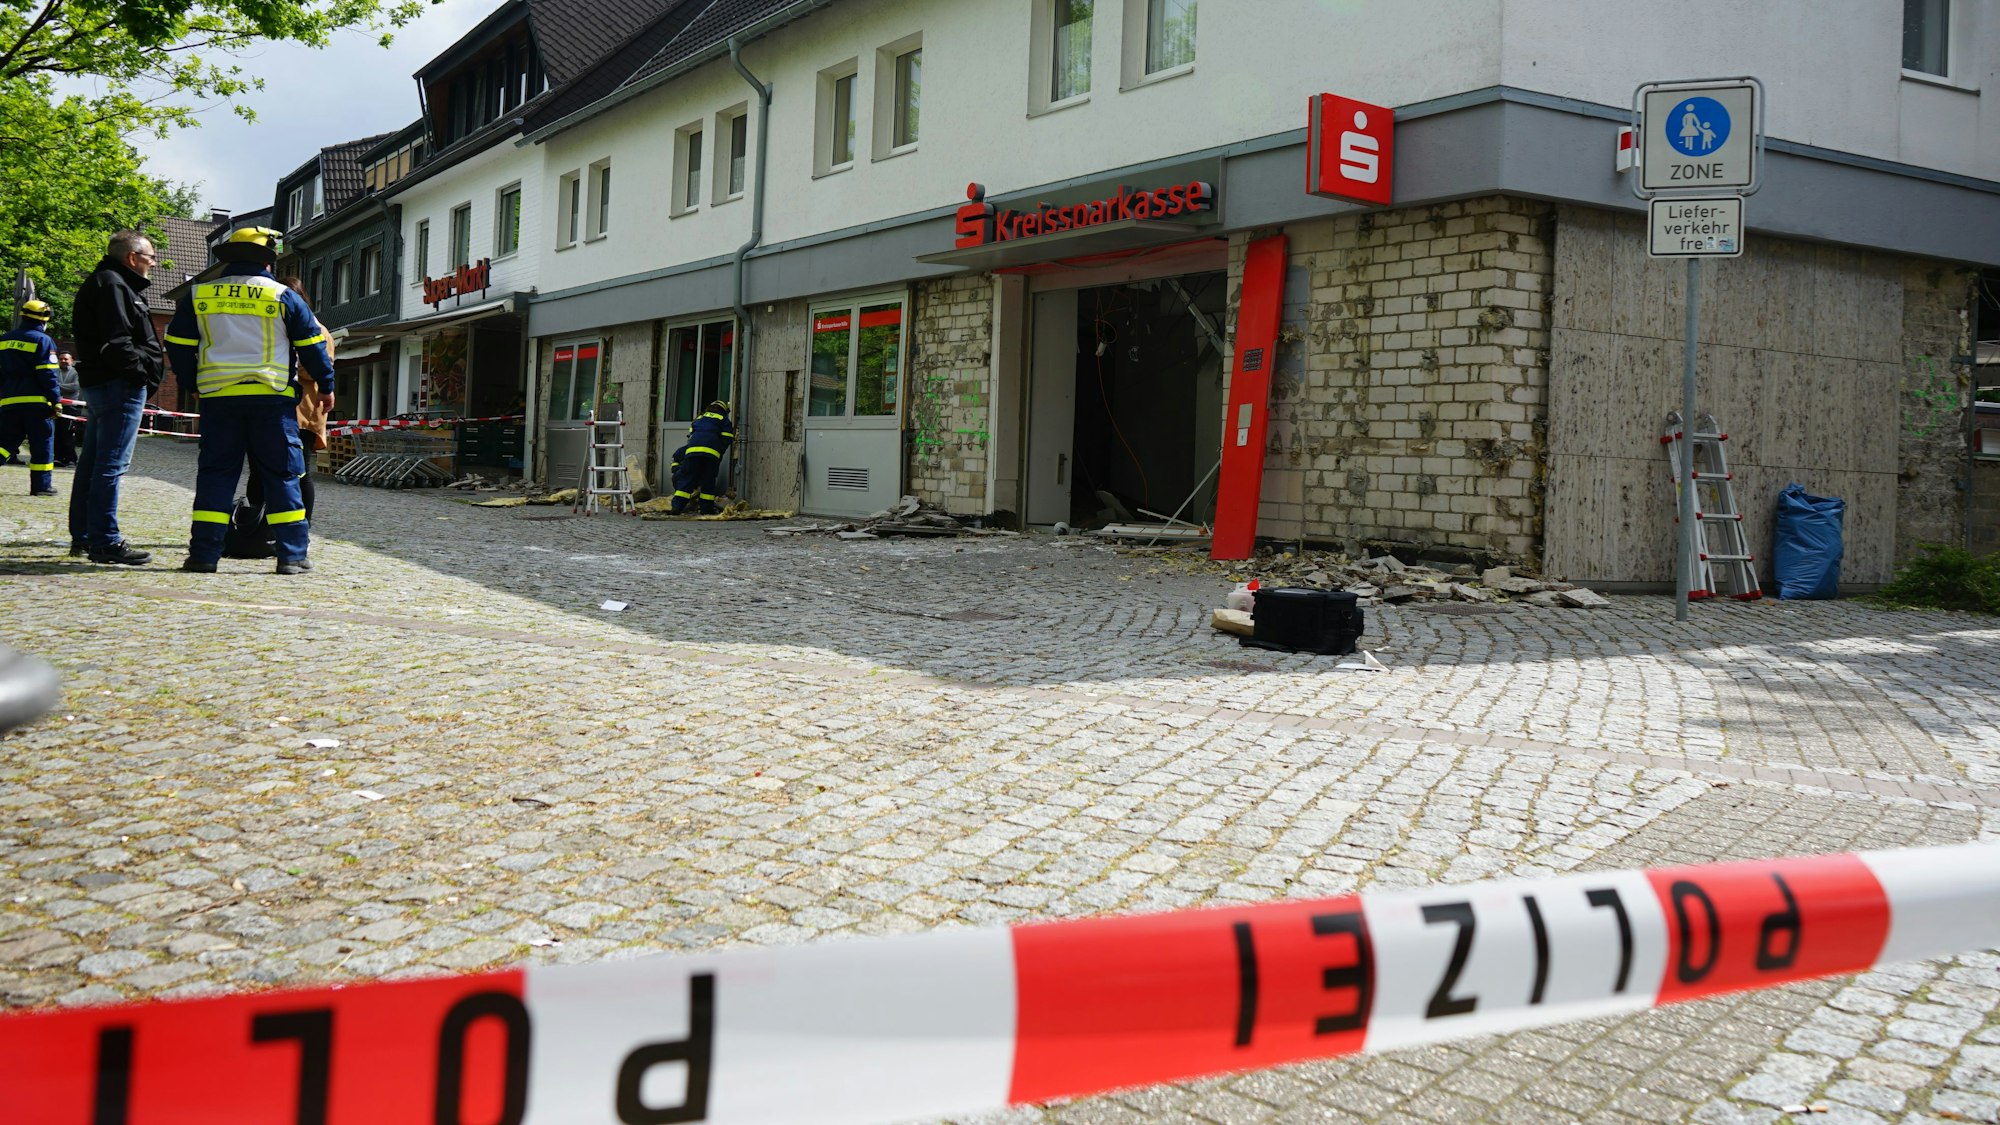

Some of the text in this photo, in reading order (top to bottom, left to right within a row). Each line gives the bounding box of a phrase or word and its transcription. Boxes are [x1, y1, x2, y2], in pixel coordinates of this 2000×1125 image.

[1670, 163, 1724, 180] ZONE
[996, 180, 1206, 242] Kreissparkasse
[1668, 204, 1726, 219] Liefer-
[1664, 221, 1730, 235] verkehr
[1680, 237, 1706, 251] fre
[213, 284, 264, 299] THW
[1233, 871, 1802, 1047] POLIZEI
